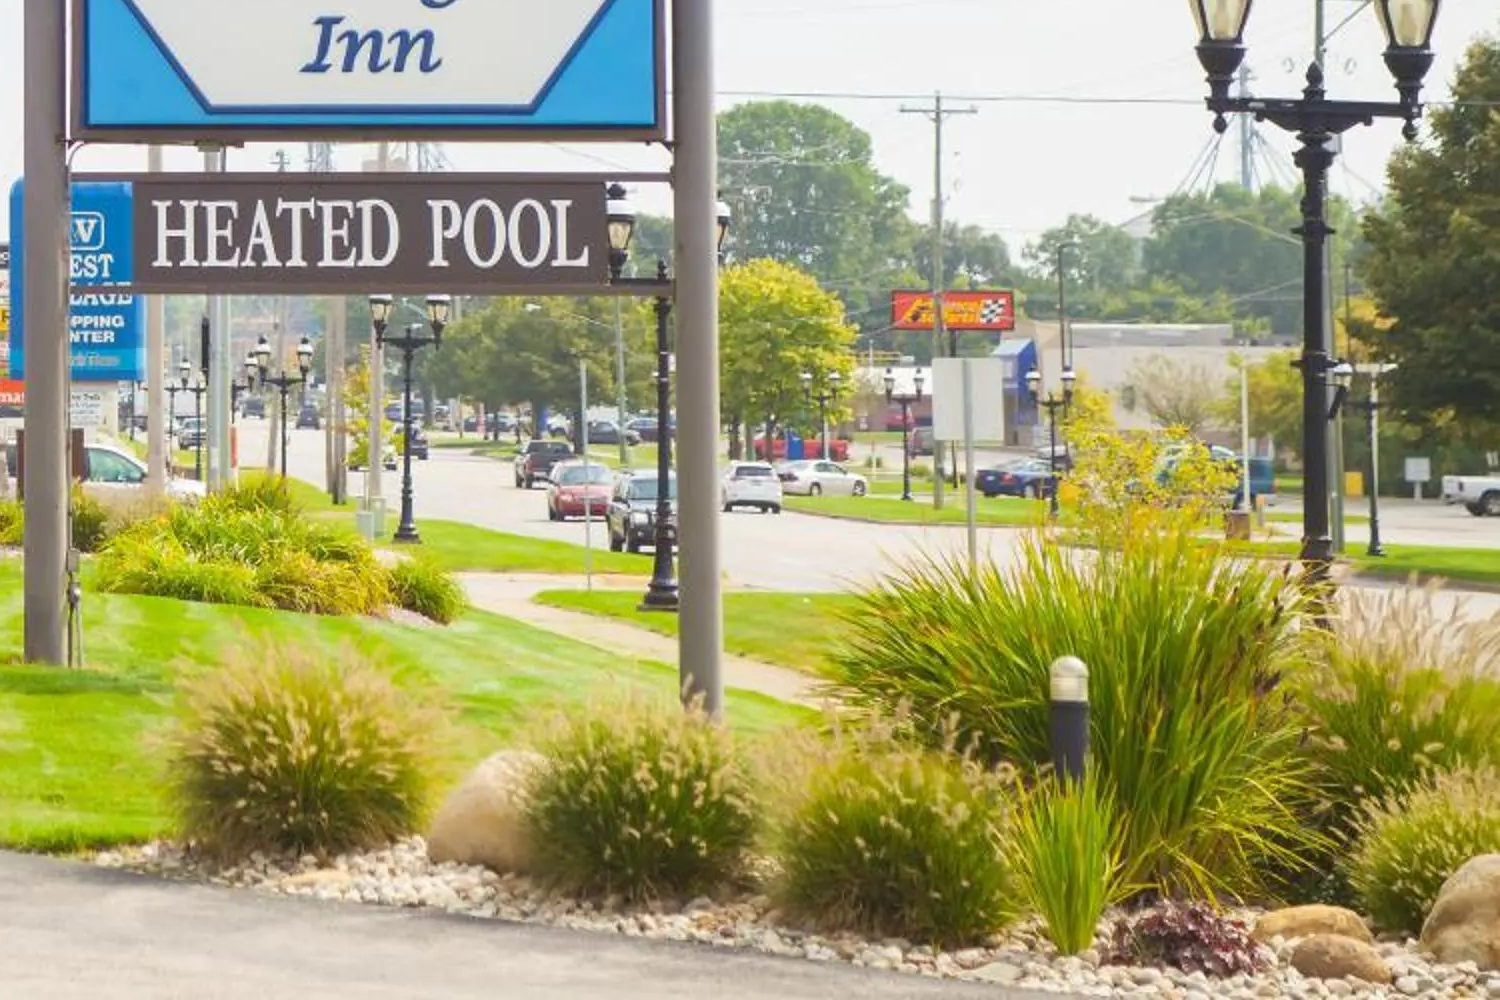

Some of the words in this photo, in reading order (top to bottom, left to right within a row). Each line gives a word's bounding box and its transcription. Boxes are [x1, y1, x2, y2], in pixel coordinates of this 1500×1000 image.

[299, 15, 442, 73] Inn
[151, 198, 400, 268] HEATED
[426, 198, 589, 268] POOL
[70, 315, 125, 328] PPING
